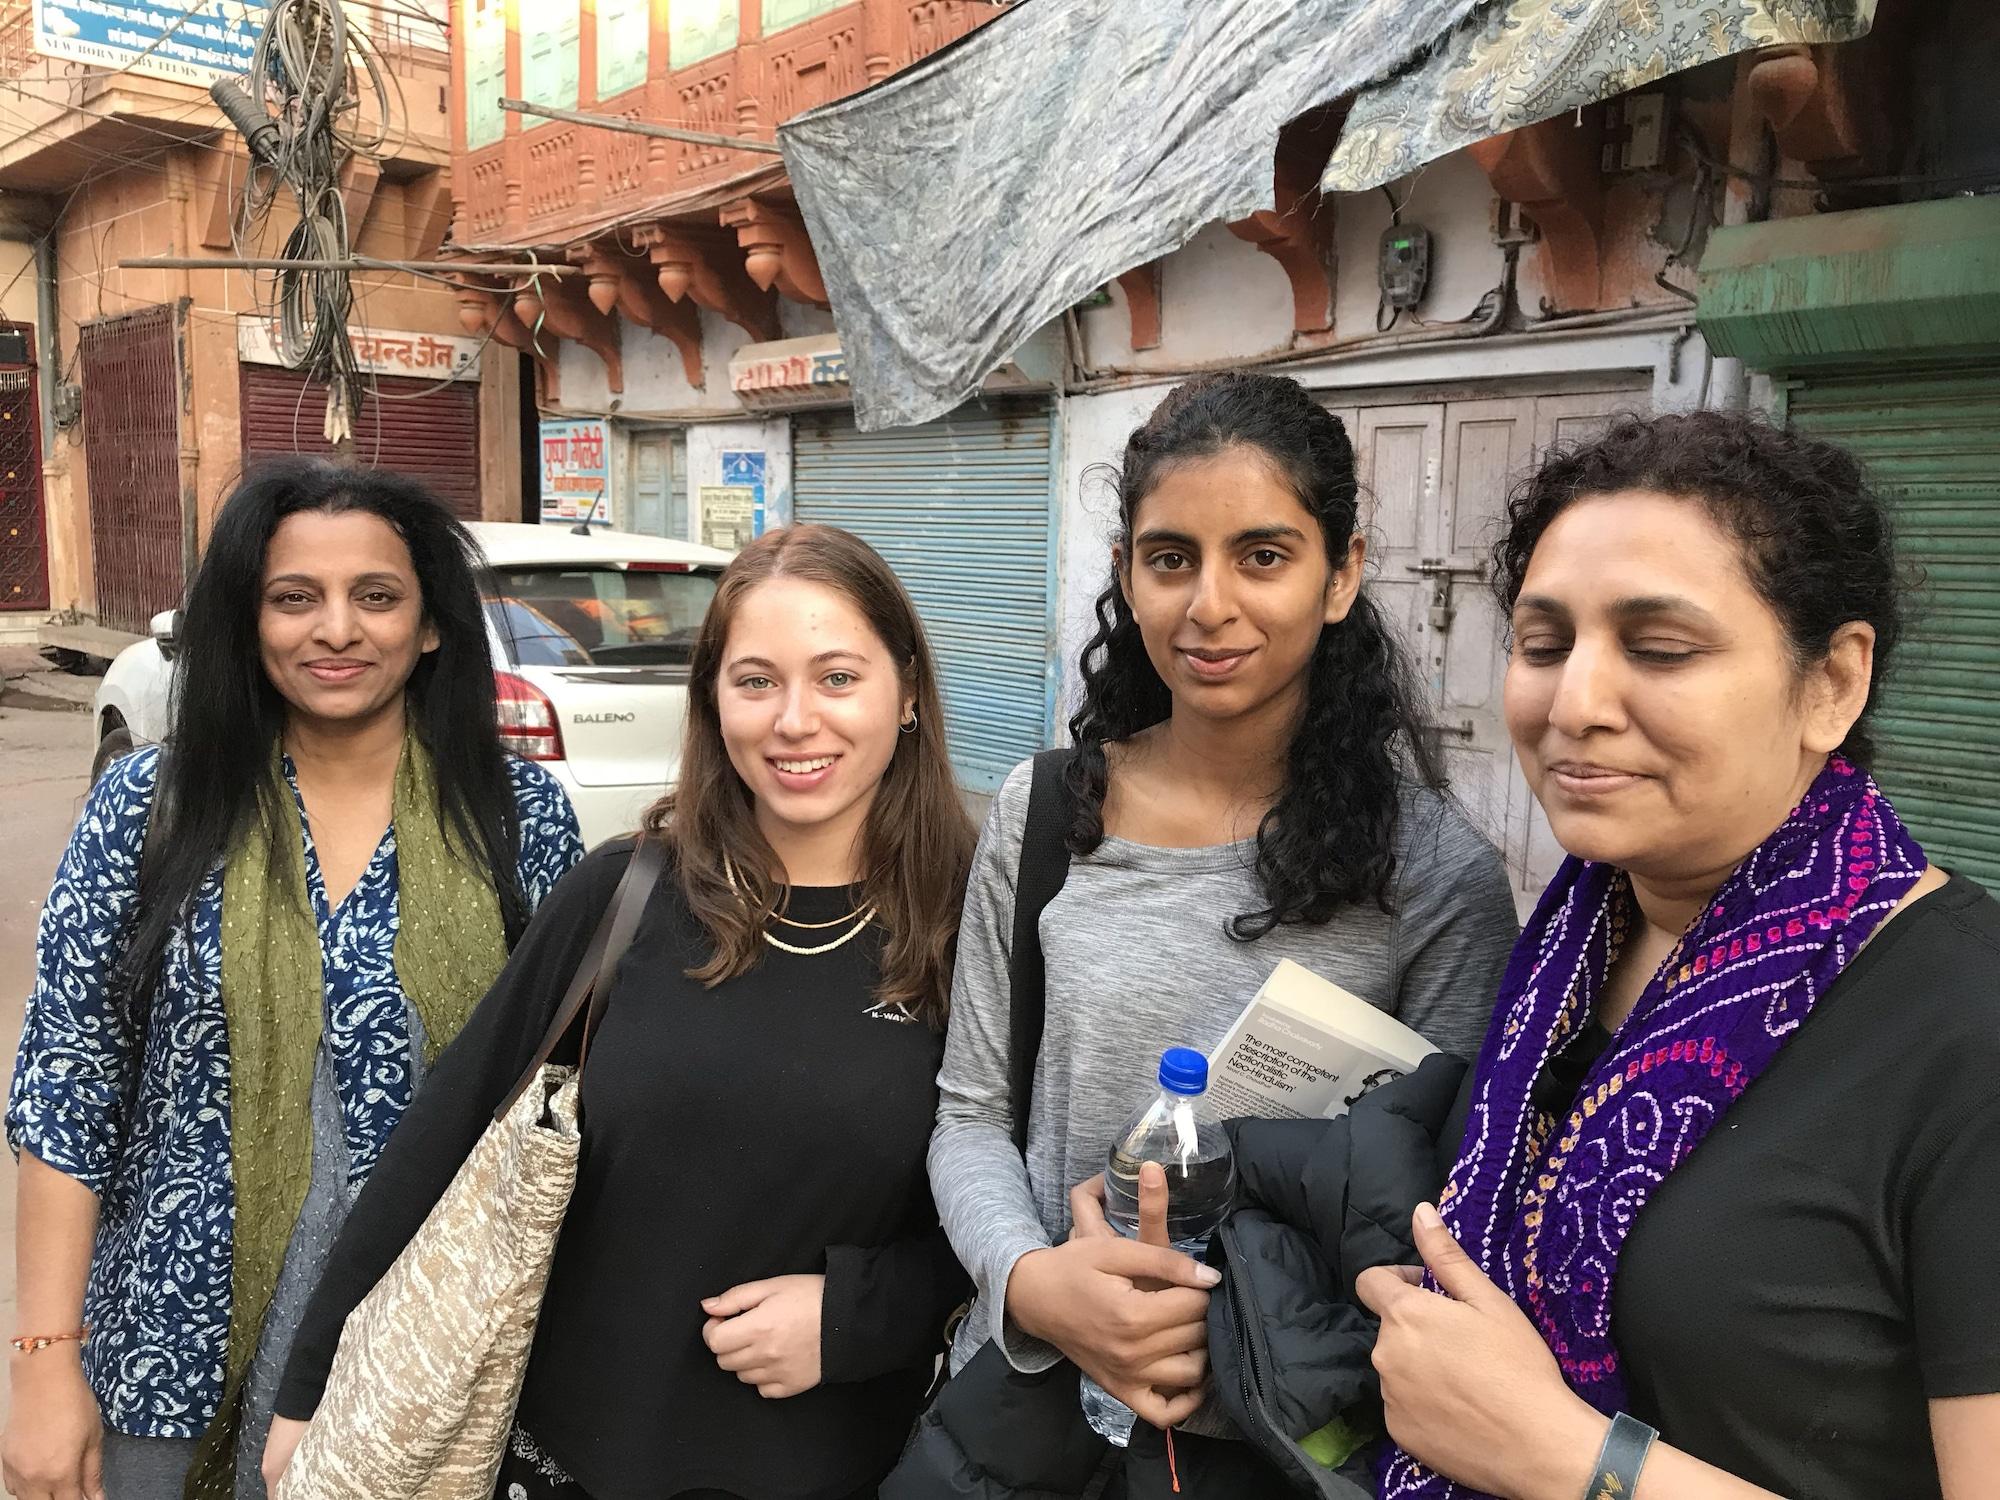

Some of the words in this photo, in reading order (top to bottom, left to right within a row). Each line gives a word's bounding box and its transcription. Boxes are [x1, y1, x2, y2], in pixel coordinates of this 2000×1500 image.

[45, 37, 71, 52] NEW
[77, 45, 115, 61] BORN
[158, 61, 198, 78] ITEMS
[573, 712, 636, 724] BALENO
[871, 1011, 907, 1023] K-WAY
[1233, 1050, 1288, 1079] nationalistic
[1238, 1043, 1289, 1070] description
[1289, 1066, 1303, 1075] of
[1300, 1069, 1317, 1083] the
[1261, 1043, 1287, 1058] most
[1285, 1054, 1339, 1082] competent
